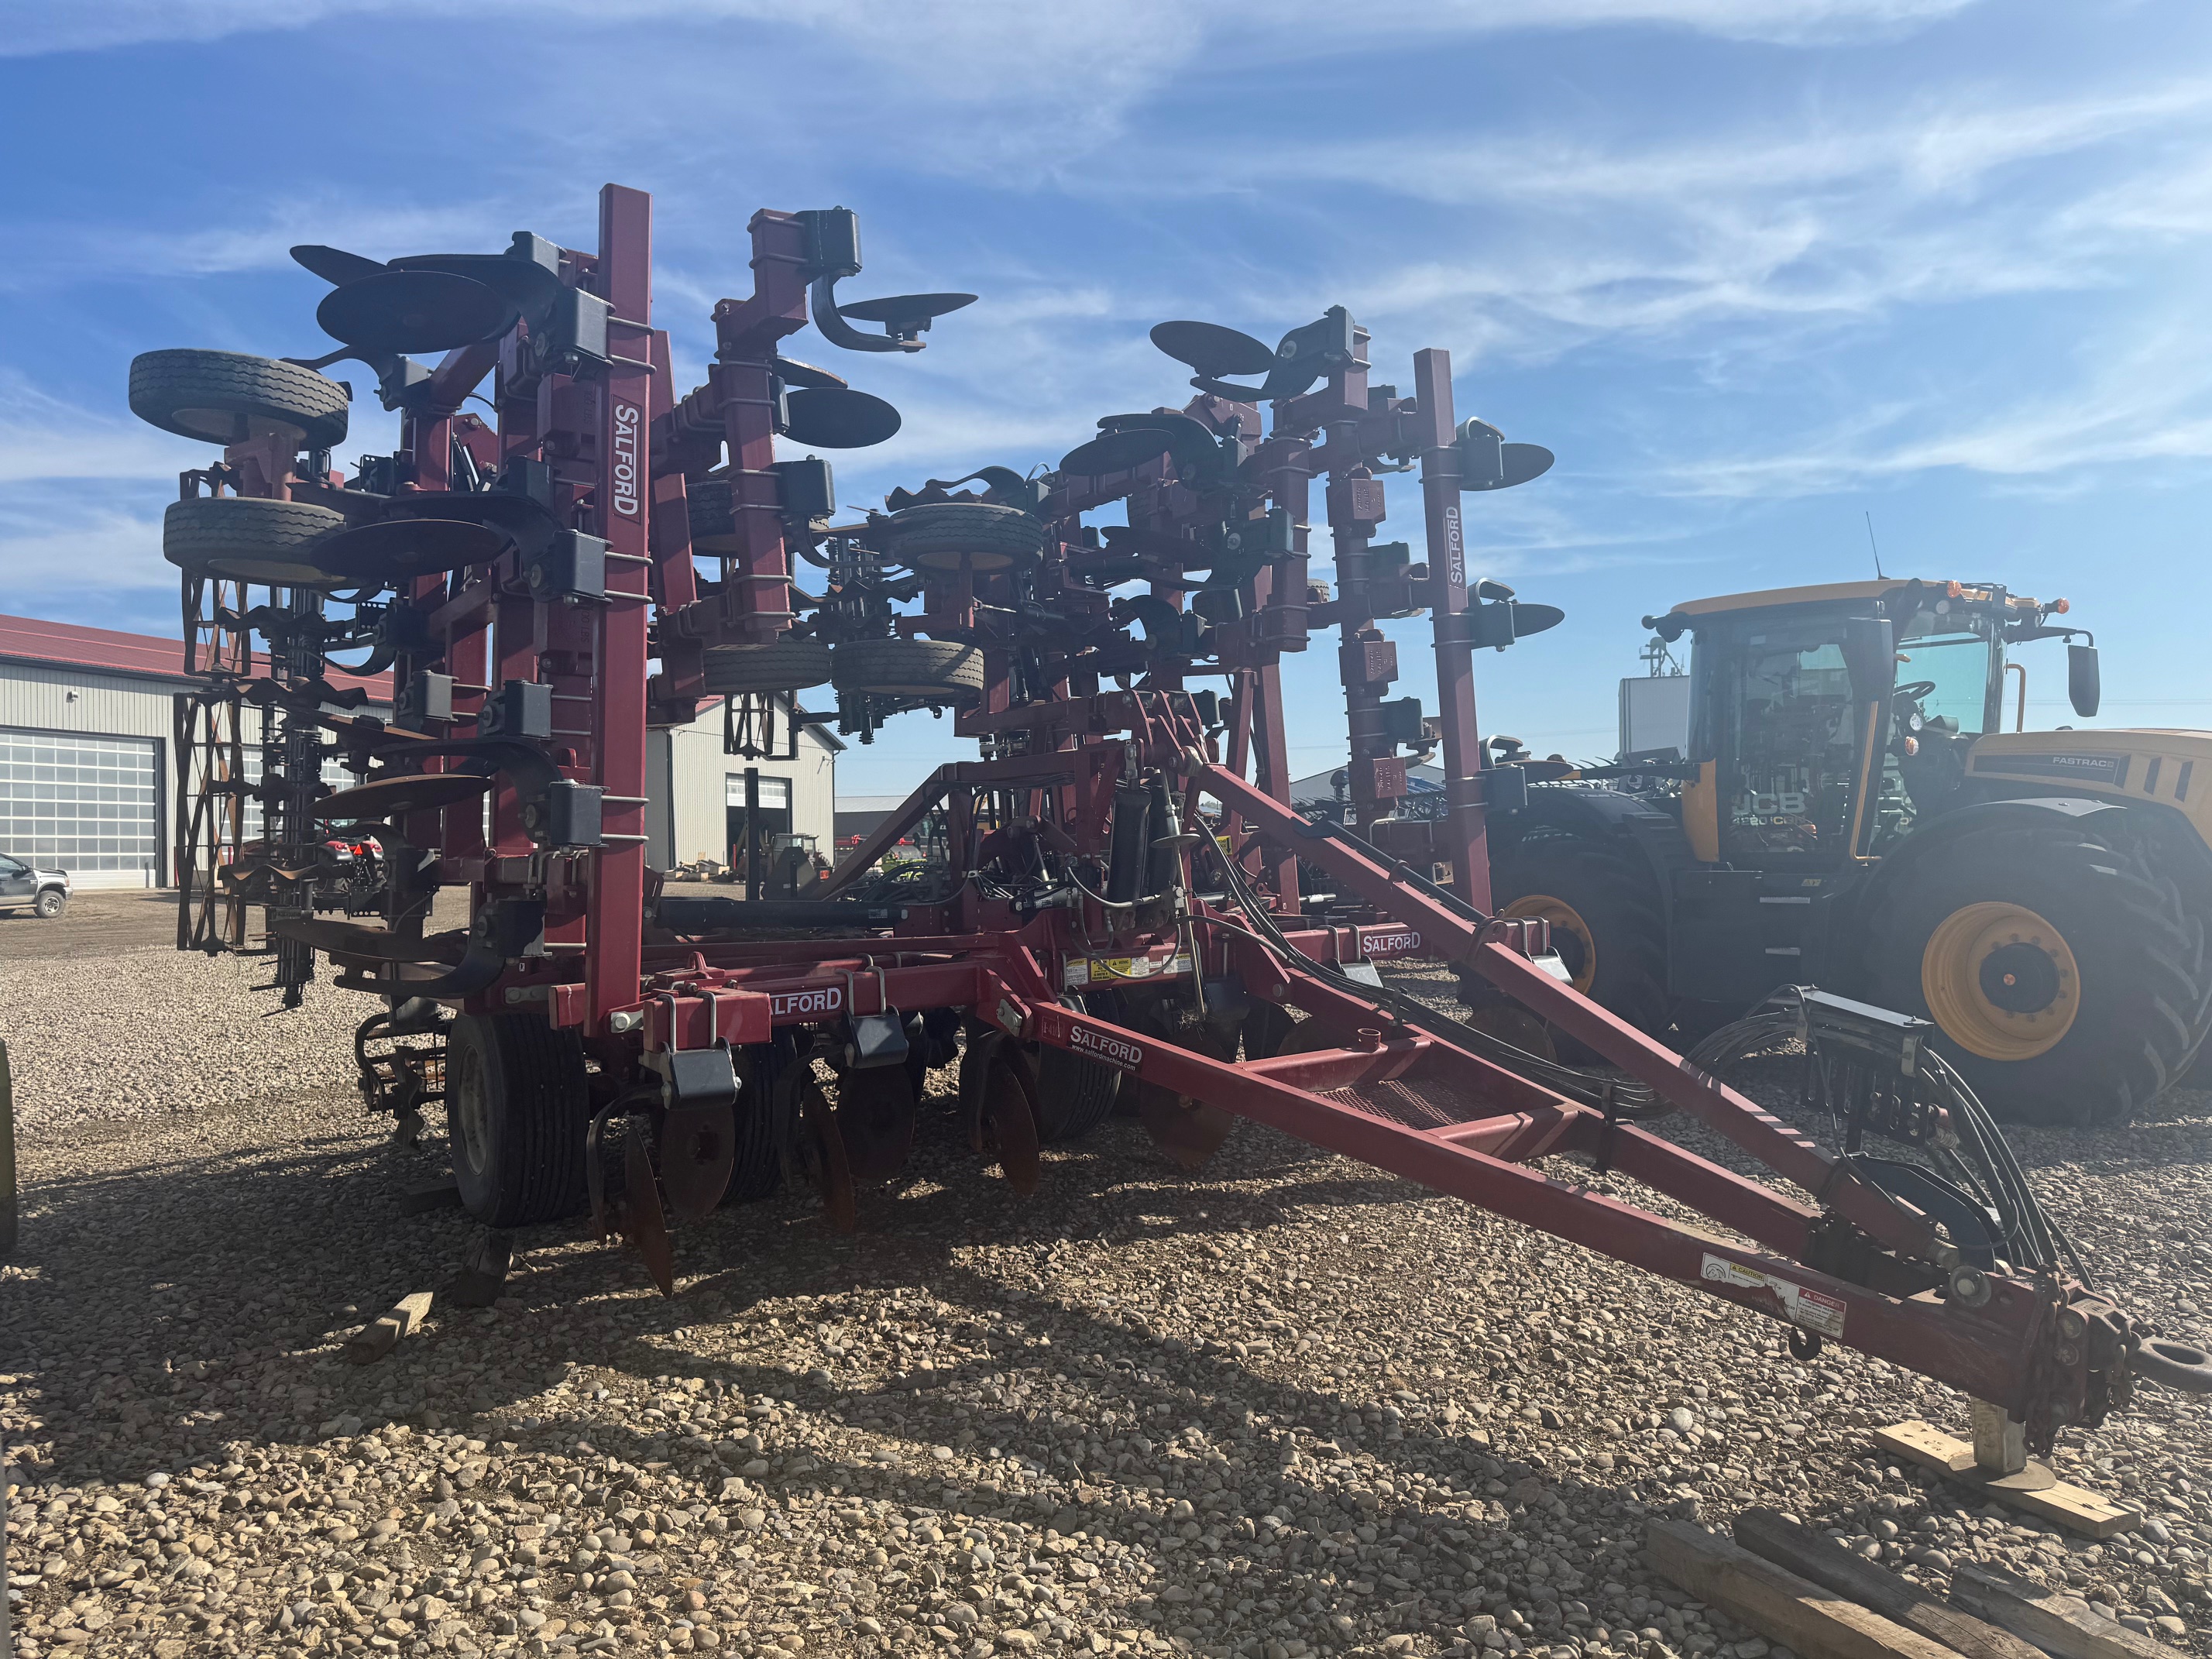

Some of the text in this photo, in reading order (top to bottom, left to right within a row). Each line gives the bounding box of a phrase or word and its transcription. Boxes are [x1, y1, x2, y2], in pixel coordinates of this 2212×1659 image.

[614, 404, 639, 516] SALFORD
[1445, 506, 1463, 584] SALFORD
[1732, 792, 1805, 815] JCB
[1363, 932, 1420, 953] SALFORD
[770, 988, 842, 1015] LFORD
[1070, 1025, 1142, 1064] SALFORD
[1071, 1044, 1136, 1071] www.salfordmachine.com
[1738, 1267, 1764, 1279] CAUTION
[1813, 1295, 1839, 1308] DANGER
